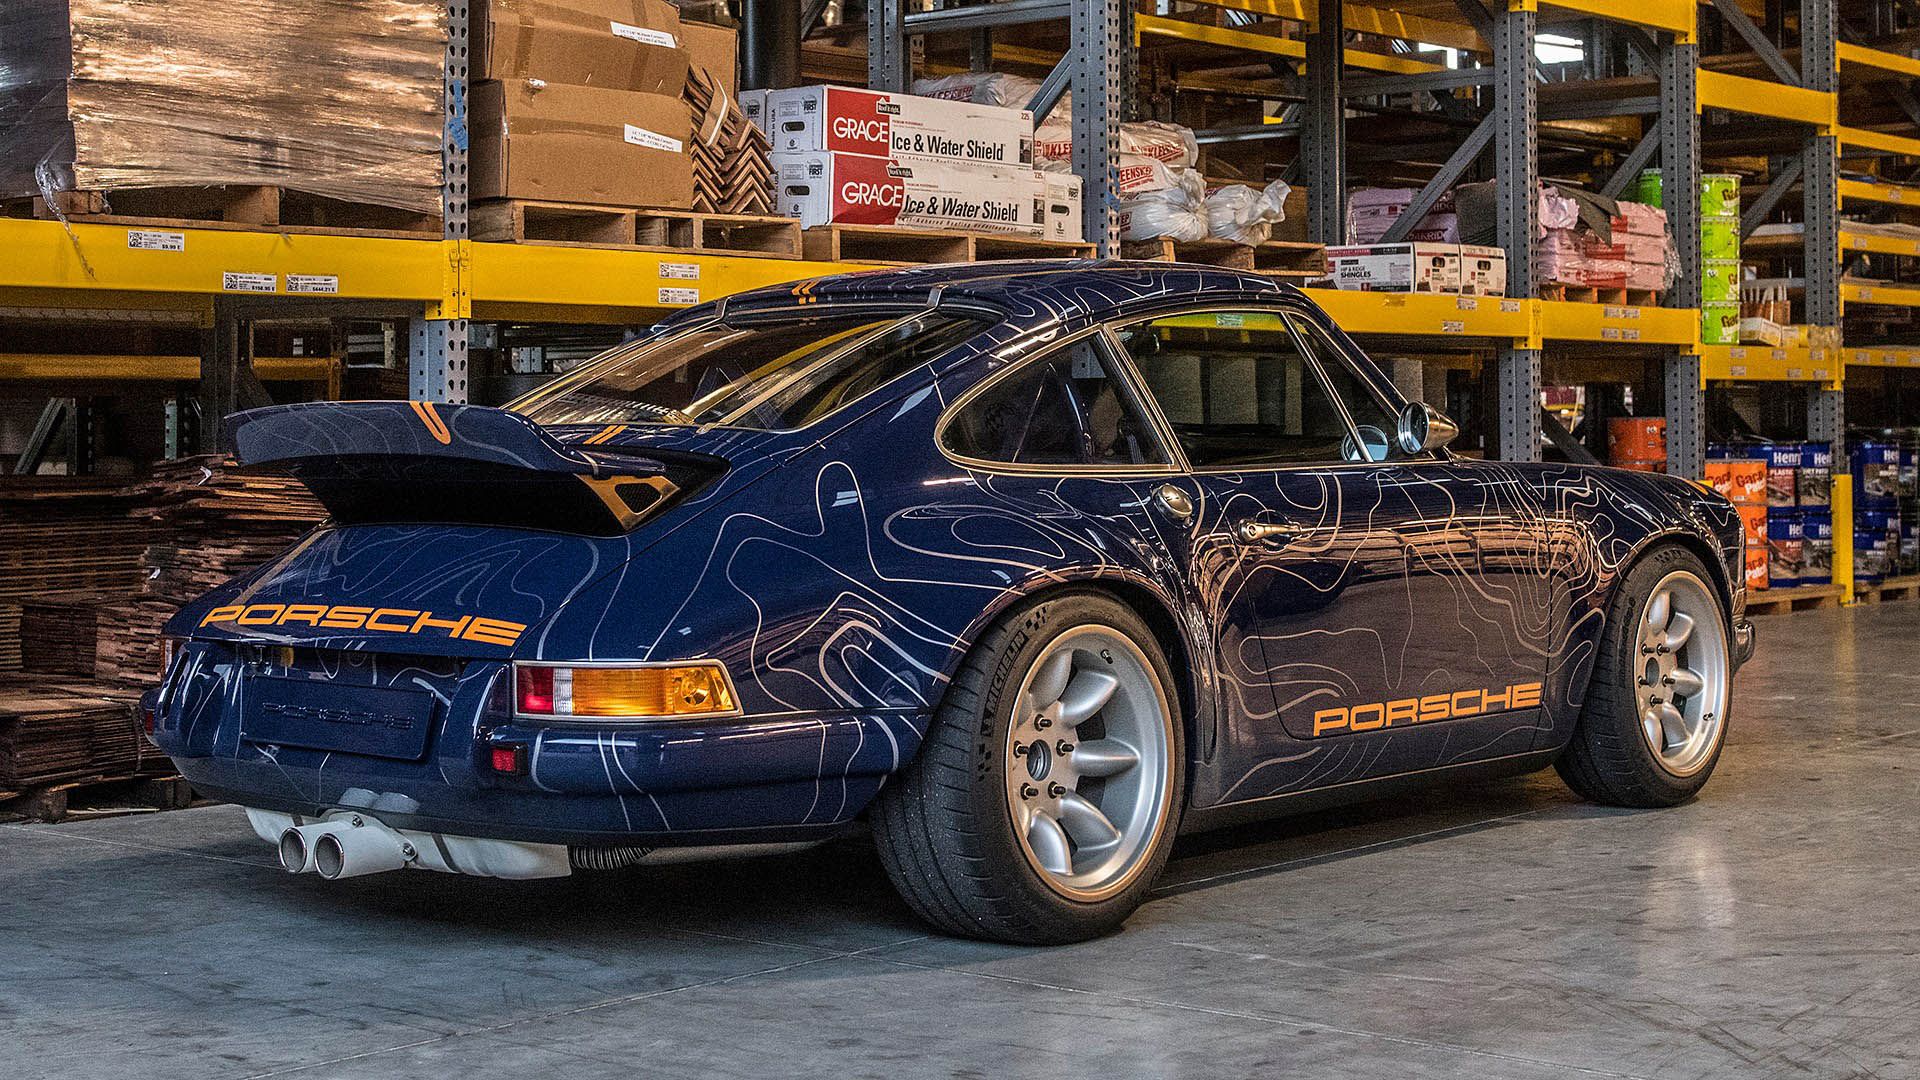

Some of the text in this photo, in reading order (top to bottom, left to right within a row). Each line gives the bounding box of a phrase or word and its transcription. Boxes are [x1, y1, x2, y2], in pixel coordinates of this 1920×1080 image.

[804, 103, 816, 111] FIRST
[833, 117, 888, 142] GRACE
[892, 131, 1003, 160] Ice & Water Shield
[842, 182, 903, 207] GRACE
[903, 195, 1017, 222] Ice & Water Shield
[1814, 453, 1831, 465] Hen
[200, 604, 527, 646] PORSCHE
[987, 630, 1026, 713] MICHELIN
[1313, 682, 1542, 736] PORSCHE
